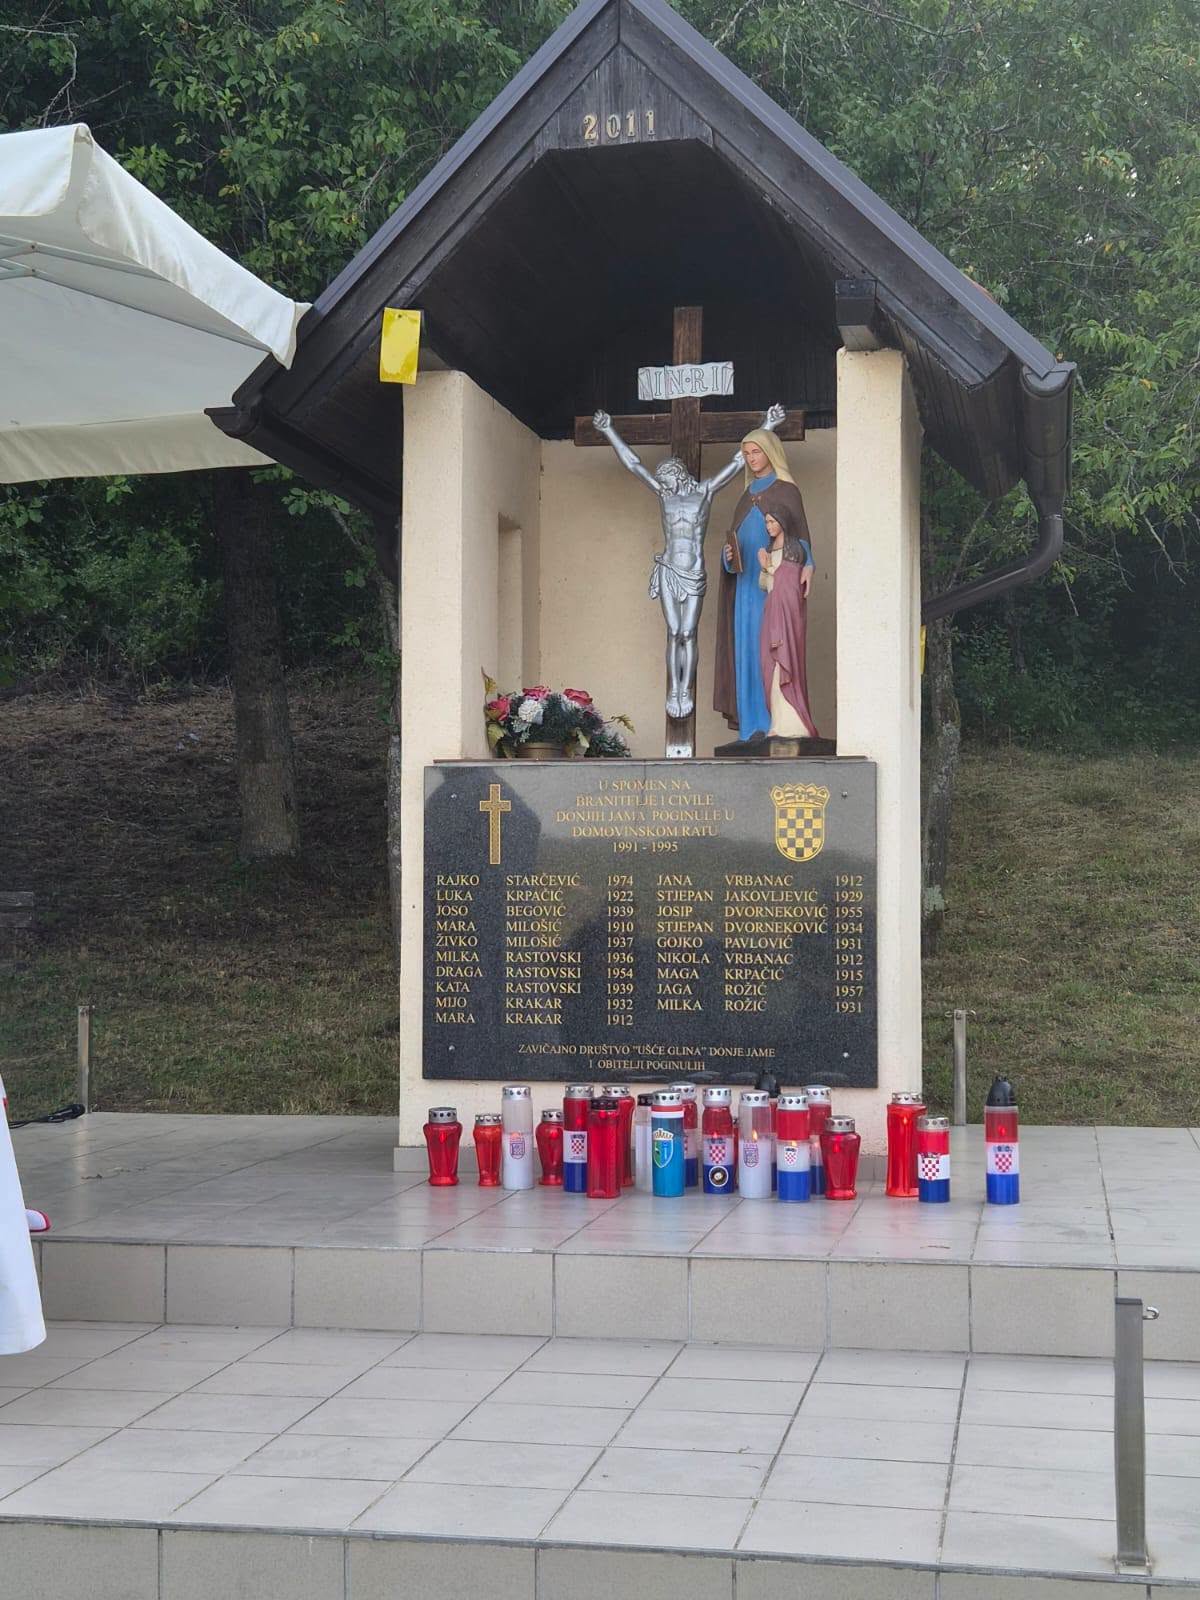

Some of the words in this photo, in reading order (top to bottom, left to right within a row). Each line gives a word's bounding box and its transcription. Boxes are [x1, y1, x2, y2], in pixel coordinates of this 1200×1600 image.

[583, 110, 656, 140] 2011
[599, 781, 608, 790] U
[612, 780, 666, 791] SPOMEN
[672, 781, 690, 790] NA
[669, 795, 713, 805] CIVILE
[556, 811, 604, 822] DONJIH
[608, 811, 645, 822] JAMA
[652, 811, 721, 821] POGINULE
[726, 811, 735, 821] U
[572, 826, 678, 837] DOMOVINSKOM
[682, 826, 718, 836] RATU
[613, 842, 638, 852] 1991
[652, 842, 678, 852] 1995
[437, 875, 479, 886] RAJKO
[506, 874, 581, 886] STARČEVIĆ
[607, 876, 633, 886] 1974
[657, 875, 692, 886] JANA
[725, 875, 793, 886] VRBANAC
[835, 875, 863, 887] 1912
[436, 891, 473, 901] LUKA
[506, 889, 563, 901] KRPAČIĆ
[607, 891, 633, 902] 1922
[657, 891, 713, 902] STJEPAN
[724, 889, 818, 902] JAKOVLJEVIĆ
[835, 891, 863, 902] 1929
[436, 906, 468, 917] JOSO
[506, 904, 566, 917] BEGOVIĆ
[607, 907, 633, 917] 1939
[657, 906, 693, 917] JOSIP
[725, 905, 828, 918] DVORNEKOVIĆ
[835, 907, 863, 918] 1955
[436, 921, 476, 932] MARA
[506, 920, 561, 932] MILOŠIĆ
[607, 922, 633, 933] 1910
[657, 922, 713, 933] STJEPAN
[725, 920, 828, 933] DVORNEKOVIĆ
[835, 923, 863, 934] 1934
[436, 935, 477, 947] ŽIVKO
[506, 935, 561, 948] MILOŠIĆ
[607, 938, 633, 948] 1937
[657, 937, 703, 948] GOJKO
[725, 936, 793, 949] PAVLOVIĆ
[835, 938, 863, 949] 1931
[436, 951, 479, 962] MILKA
[506, 952, 581, 963] RASTOVSKI
[607, 953, 633, 964] 1936
[657, 953, 710, 964] NIKOLA
[726, 953, 794, 964] VRBANAC
[835, 954, 863, 965] 1912
[436, 967, 483, 977] DRAGA
[506, 967, 581, 978] RASTOVSKI
[607, 968, 633, 979] 1954
[657, 968, 699, 979] MAGA
[725, 967, 784, 980] KRPAČIĆ
[835, 970, 863, 981] 1915
[436, 982, 470, 992] KATA
[506, 982, 581, 994] RASTOVSKI
[607, 984, 633, 995] 1939
[657, 984, 692, 995] JAGA
[725, 982, 767, 995] ROŽIĆ
[835, 985, 863, 997] 1957
[436, 997, 467, 1008] MIJO
[506, 998, 562, 1009] KRAKAR
[607, 999, 633, 1010] 1932
[657, 999, 702, 1011] MILKA
[725, 998, 767, 1011] ROŽIĆ
[835, 1001, 863, 1012] 1931
[435, 1013, 475, 1023] MARA
[506, 1013, 563, 1024] KRAKAR
[607, 1015, 633, 1026] 1912
[518, 1043, 576, 1054] ZAVIČAJNO
[579, 1044, 629, 1055] DRUŠTVO
[709, 1047, 744, 1057] DONJE
[746, 1048, 775, 1057] JAME
[597, 1060, 644, 1070] OBITELJI
[646, 1060, 705, 1071] POGINULIH
